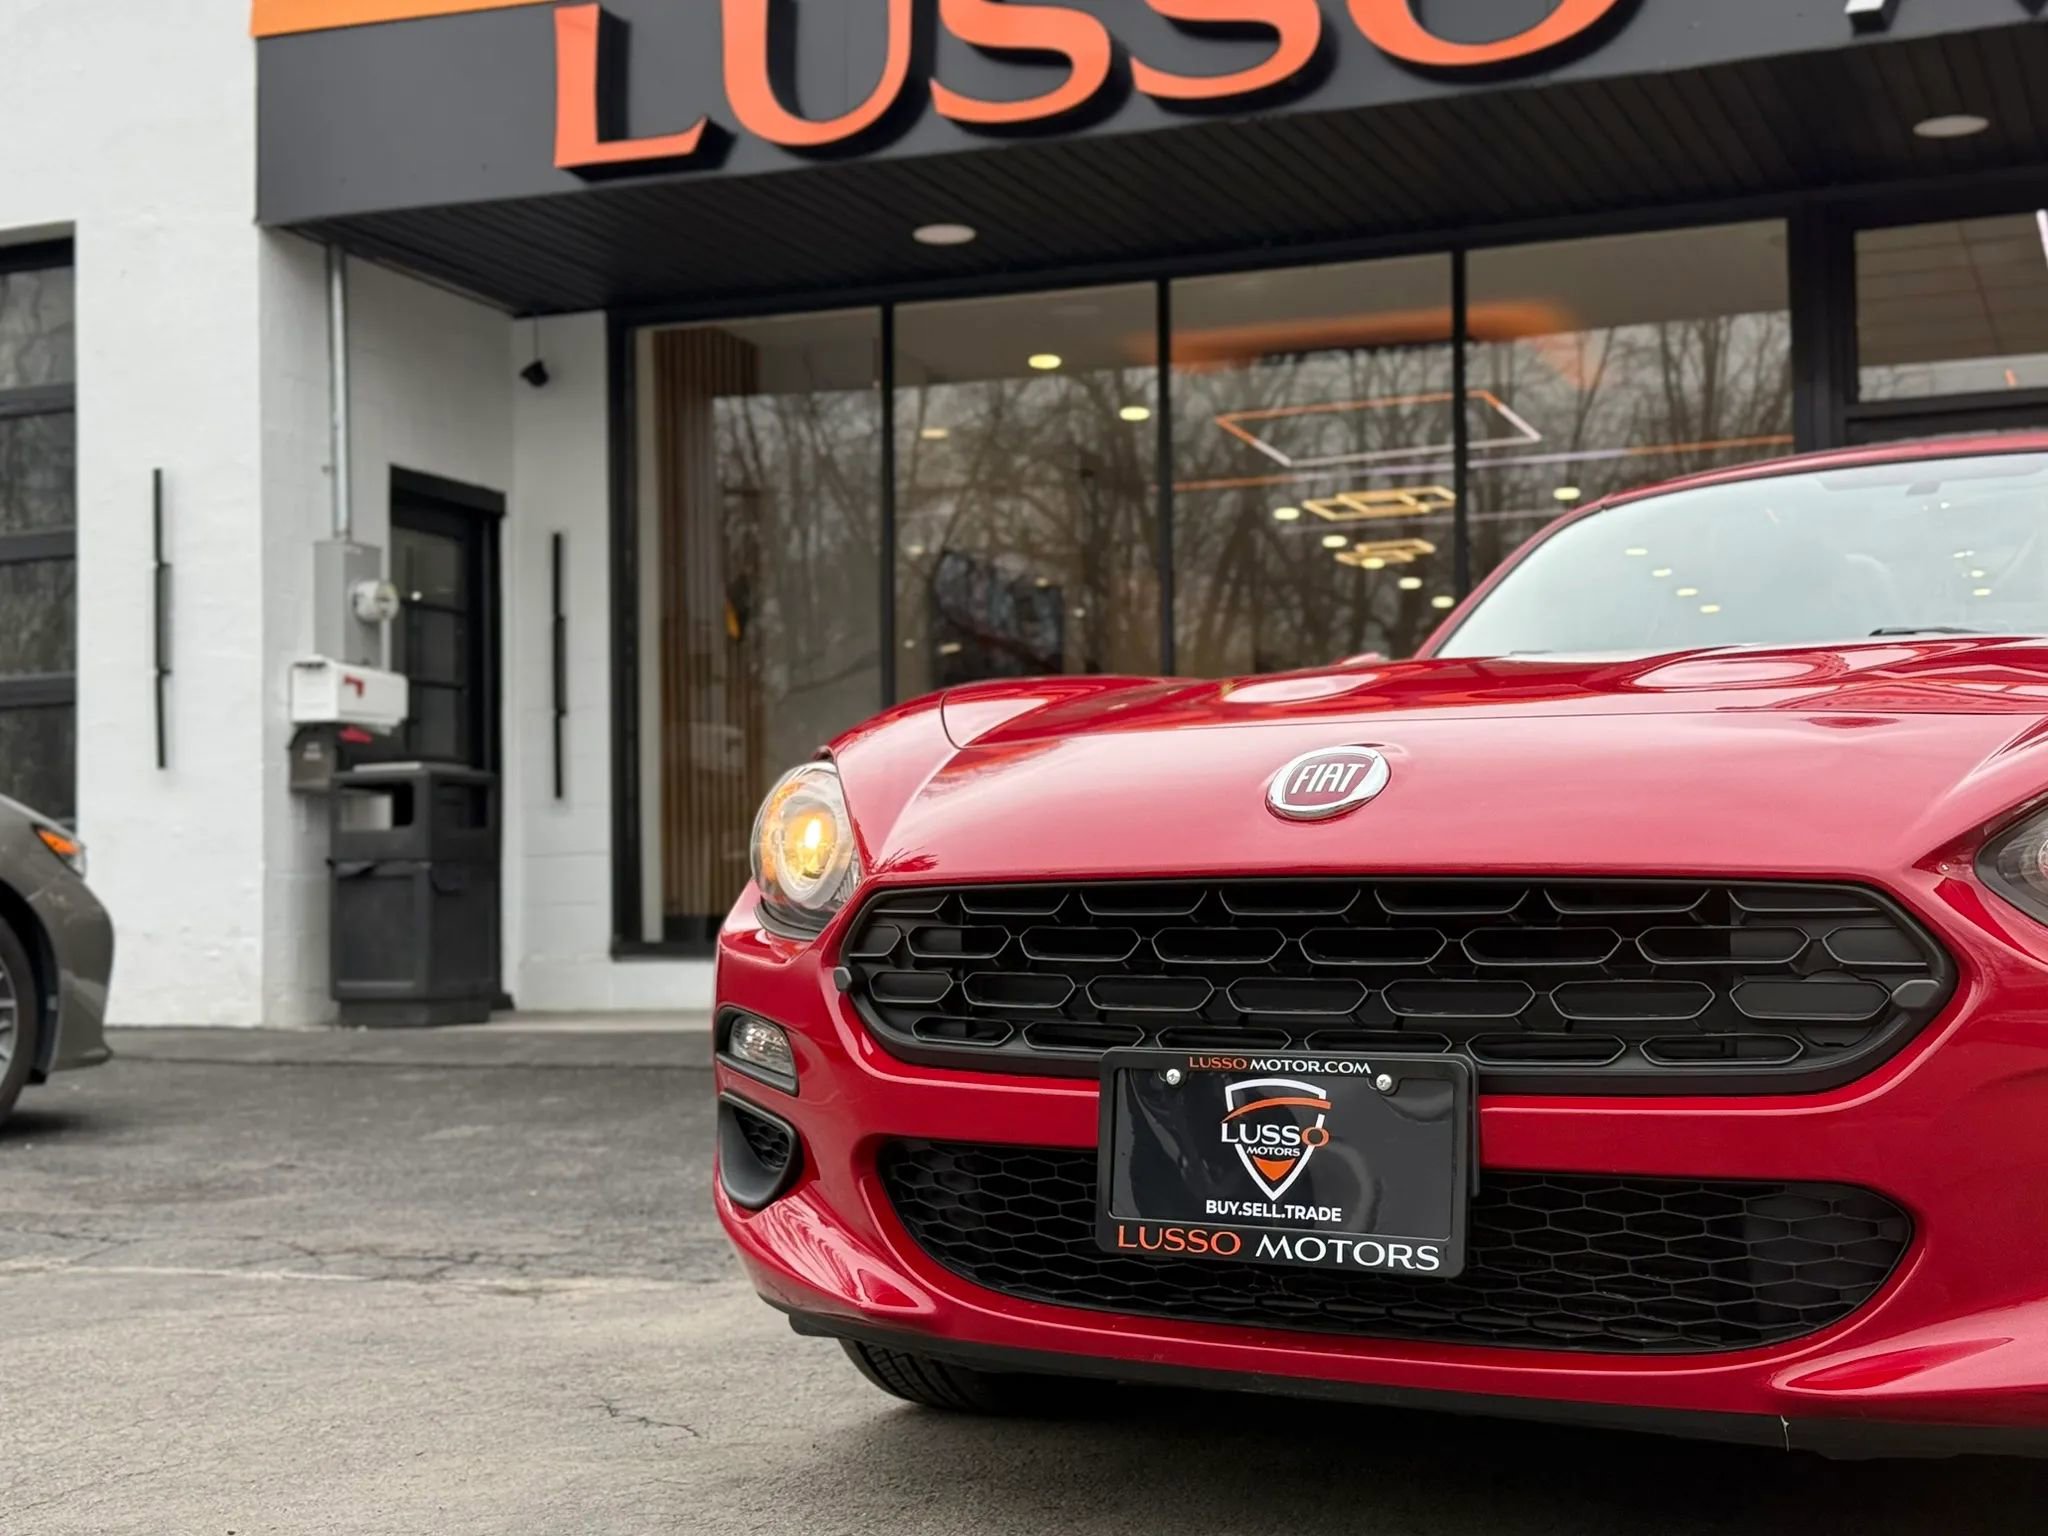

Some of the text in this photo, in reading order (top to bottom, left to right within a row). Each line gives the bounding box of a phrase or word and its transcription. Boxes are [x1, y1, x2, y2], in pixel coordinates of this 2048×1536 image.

[1290, 762, 1366, 794] FIAT
[1221, 1123, 1330, 1147] LUSSO
[1246, 1146, 1301, 1157] MOTORS
[1205, 1199, 1342, 1222] BUY.SELL.TRADE
[1117, 1225, 1440, 1271] LUSSO MOTORS
